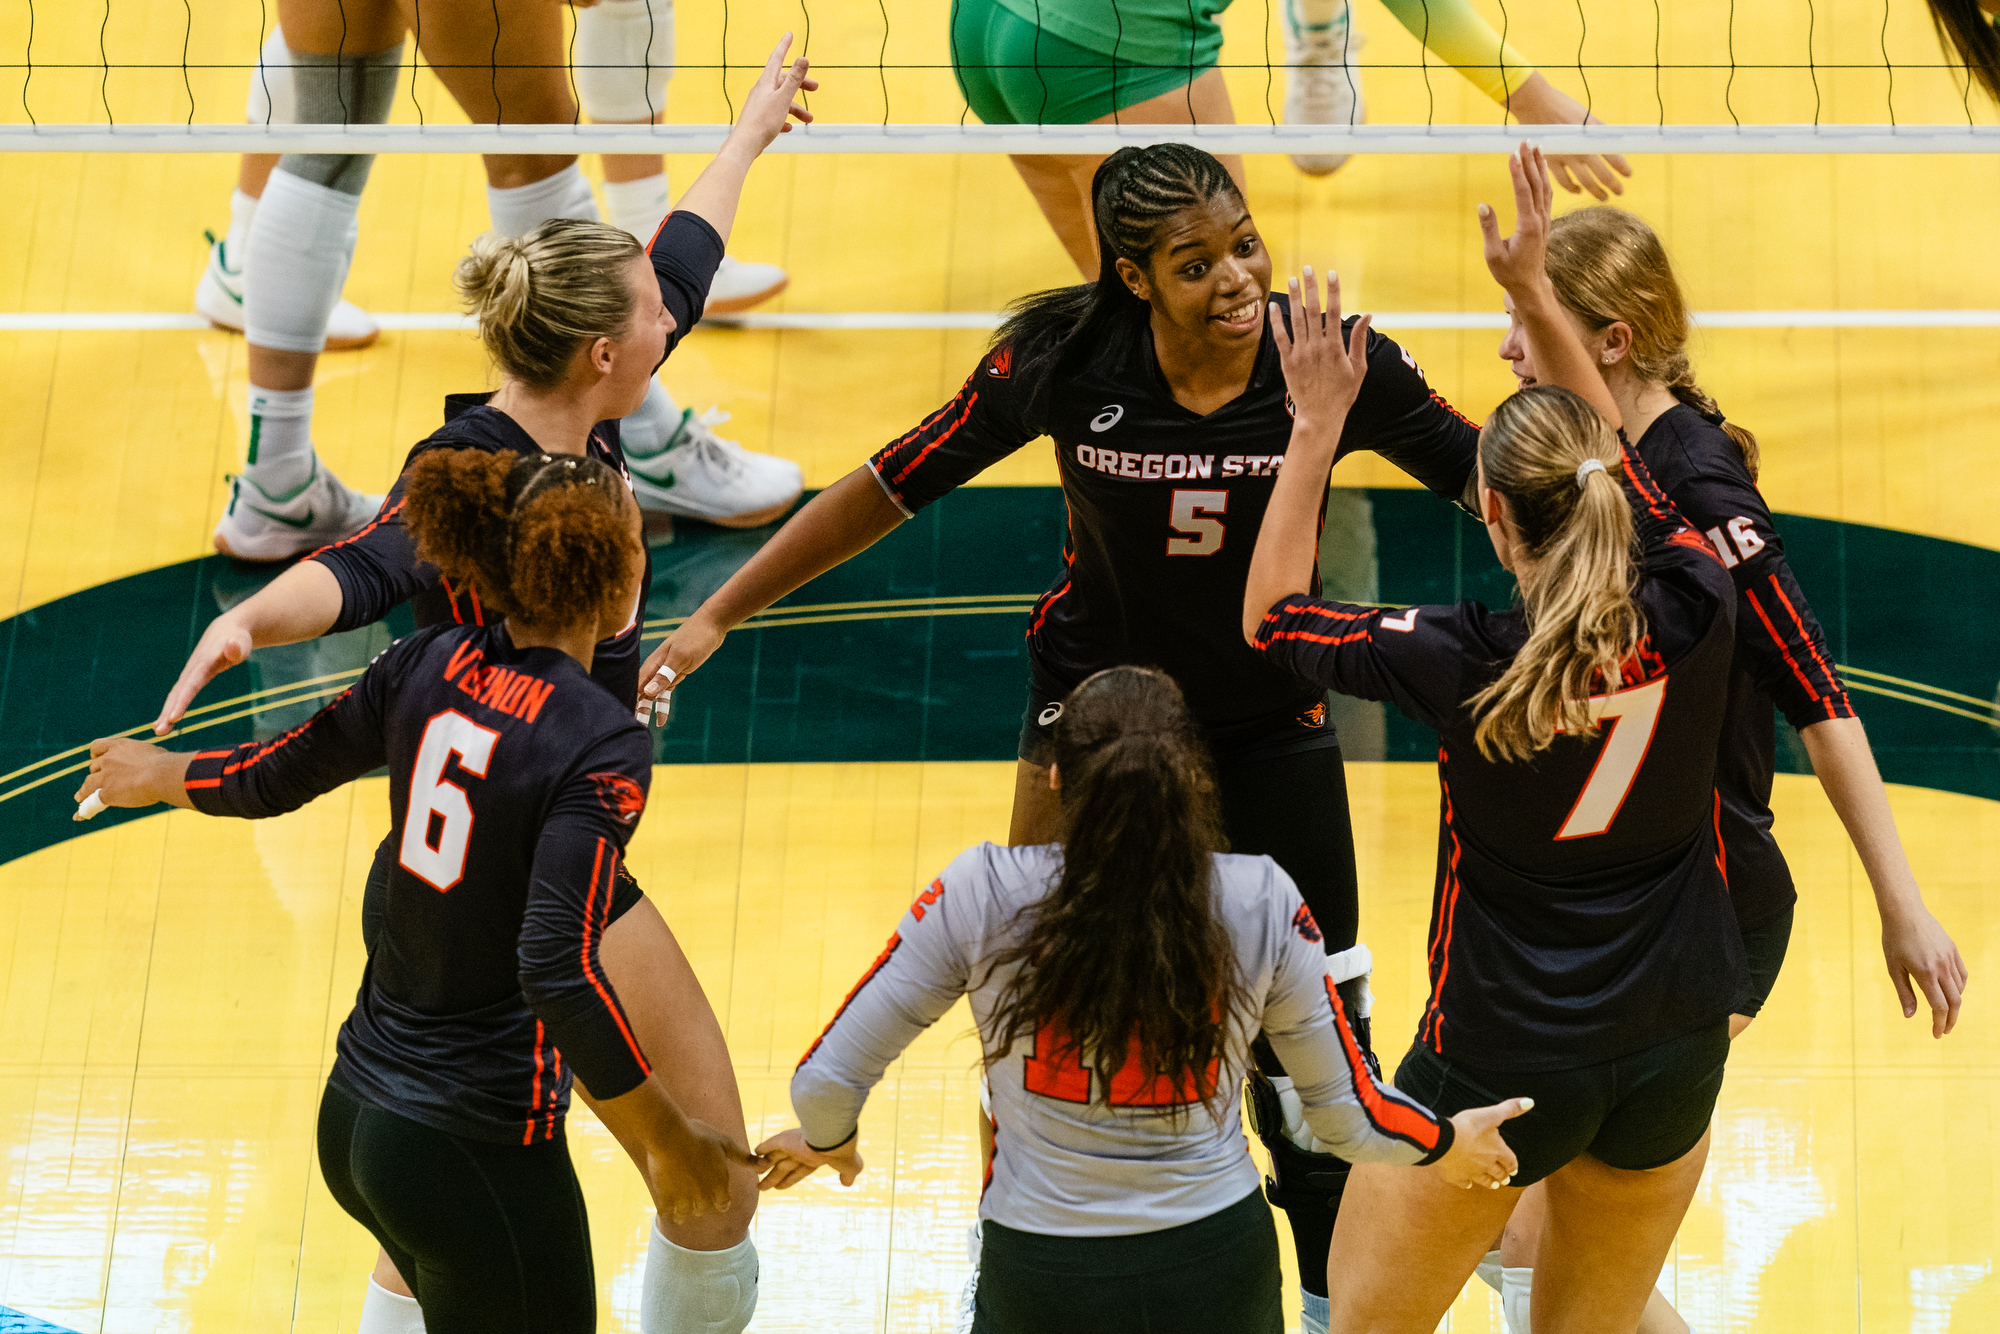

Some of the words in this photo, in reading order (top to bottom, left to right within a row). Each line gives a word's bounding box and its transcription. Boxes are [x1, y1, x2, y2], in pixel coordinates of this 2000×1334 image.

[1076, 444, 1215, 479] OREGON
[1221, 454, 1285, 478] STA
[1166, 488, 1229, 556] 5
[1705, 516, 1766, 569] 16
[1553, 674, 1669, 841] 7
[399, 707, 501, 893] 6
